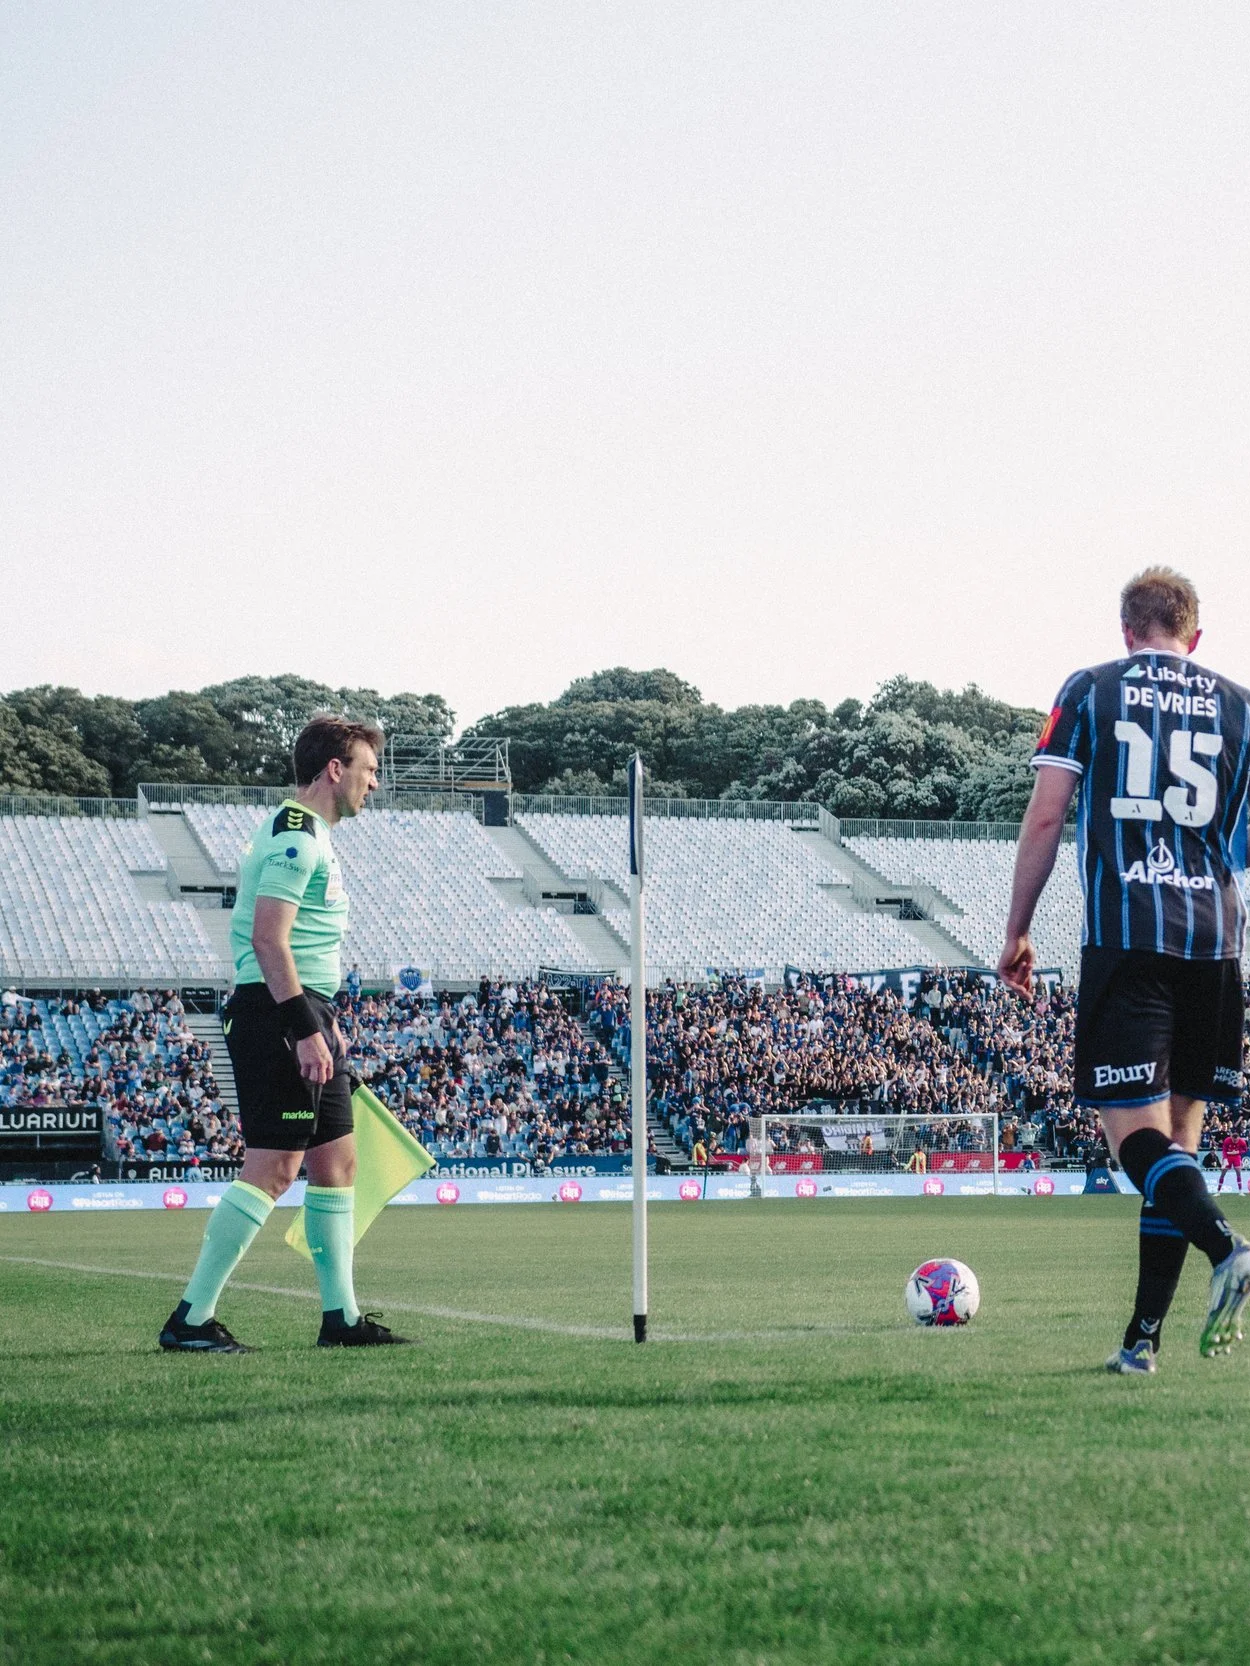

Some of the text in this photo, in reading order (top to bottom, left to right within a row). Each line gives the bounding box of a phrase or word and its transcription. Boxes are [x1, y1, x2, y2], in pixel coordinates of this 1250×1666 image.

[1146, 665, 1216, 693] Liberty
[1124, 686, 1218, 718] DE VRIES
[1110, 720, 1223, 828] 15
[1120, 860, 1215, 890] Anchor
[1093, 1062, 1157, 1087] Ebury
[282, 1110, 315, 1119] markka
[425, 1161, 596, 1178] National Plasure
